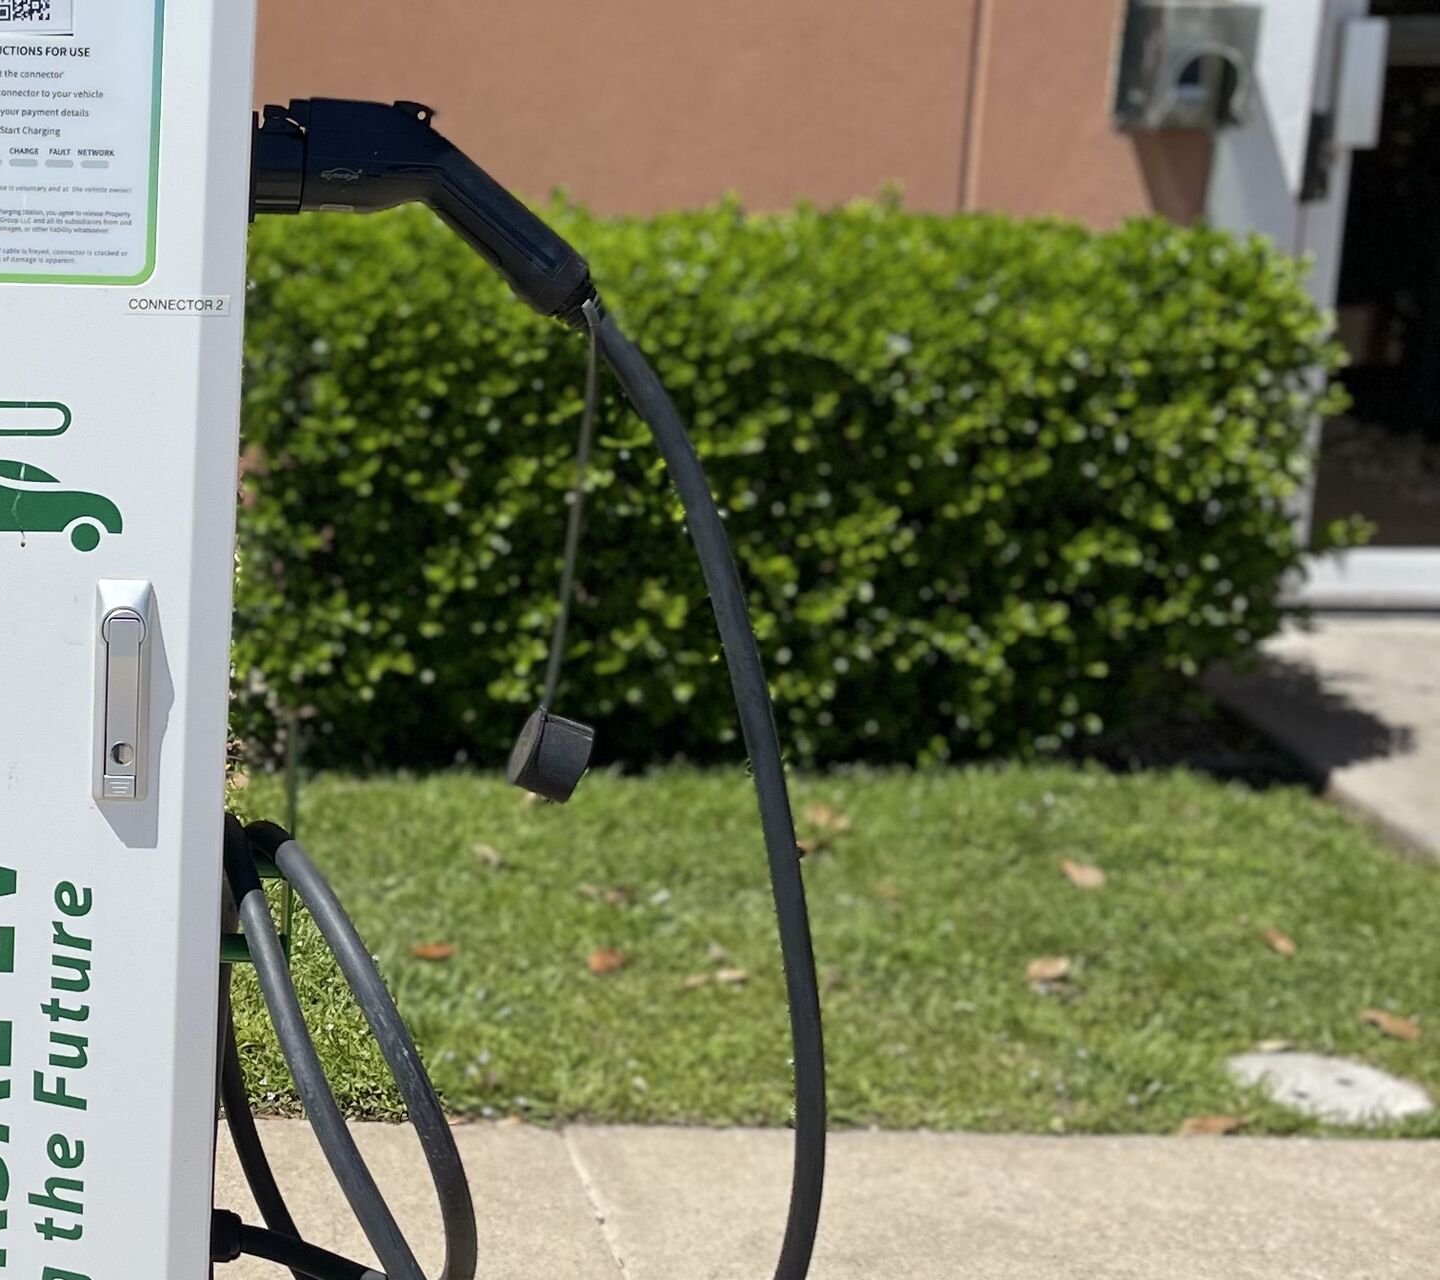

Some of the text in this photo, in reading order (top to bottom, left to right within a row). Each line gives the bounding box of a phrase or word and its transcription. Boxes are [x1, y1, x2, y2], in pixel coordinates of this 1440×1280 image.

[45, 46, 67, 57] FOR
[69, 47, 91, 58] USE
[4, 69, 18, 78] the
[20, 70, 64, 79] connector
[41, 90, 50, 98] to
[51, 91, 71, 99] your
[73, 90, 104, 99] vehicle
[0, 108, 19, 117] your
[21, 108, 60, 118] payment
[60, 108, 90, 117] details
[0, 125, 21, 135] Start
[21, 126, 61, 137] Charging
[9, 147, 39, 155] CHARGE
[48, 148, 72, 156] FAULT
[77, 149, 115, 157] NETWORK
[128, 297, 224, 311] CONNECTOR 2
[33, 879, 94, 1112] Future
[33, 1132, 86, 1243] the
